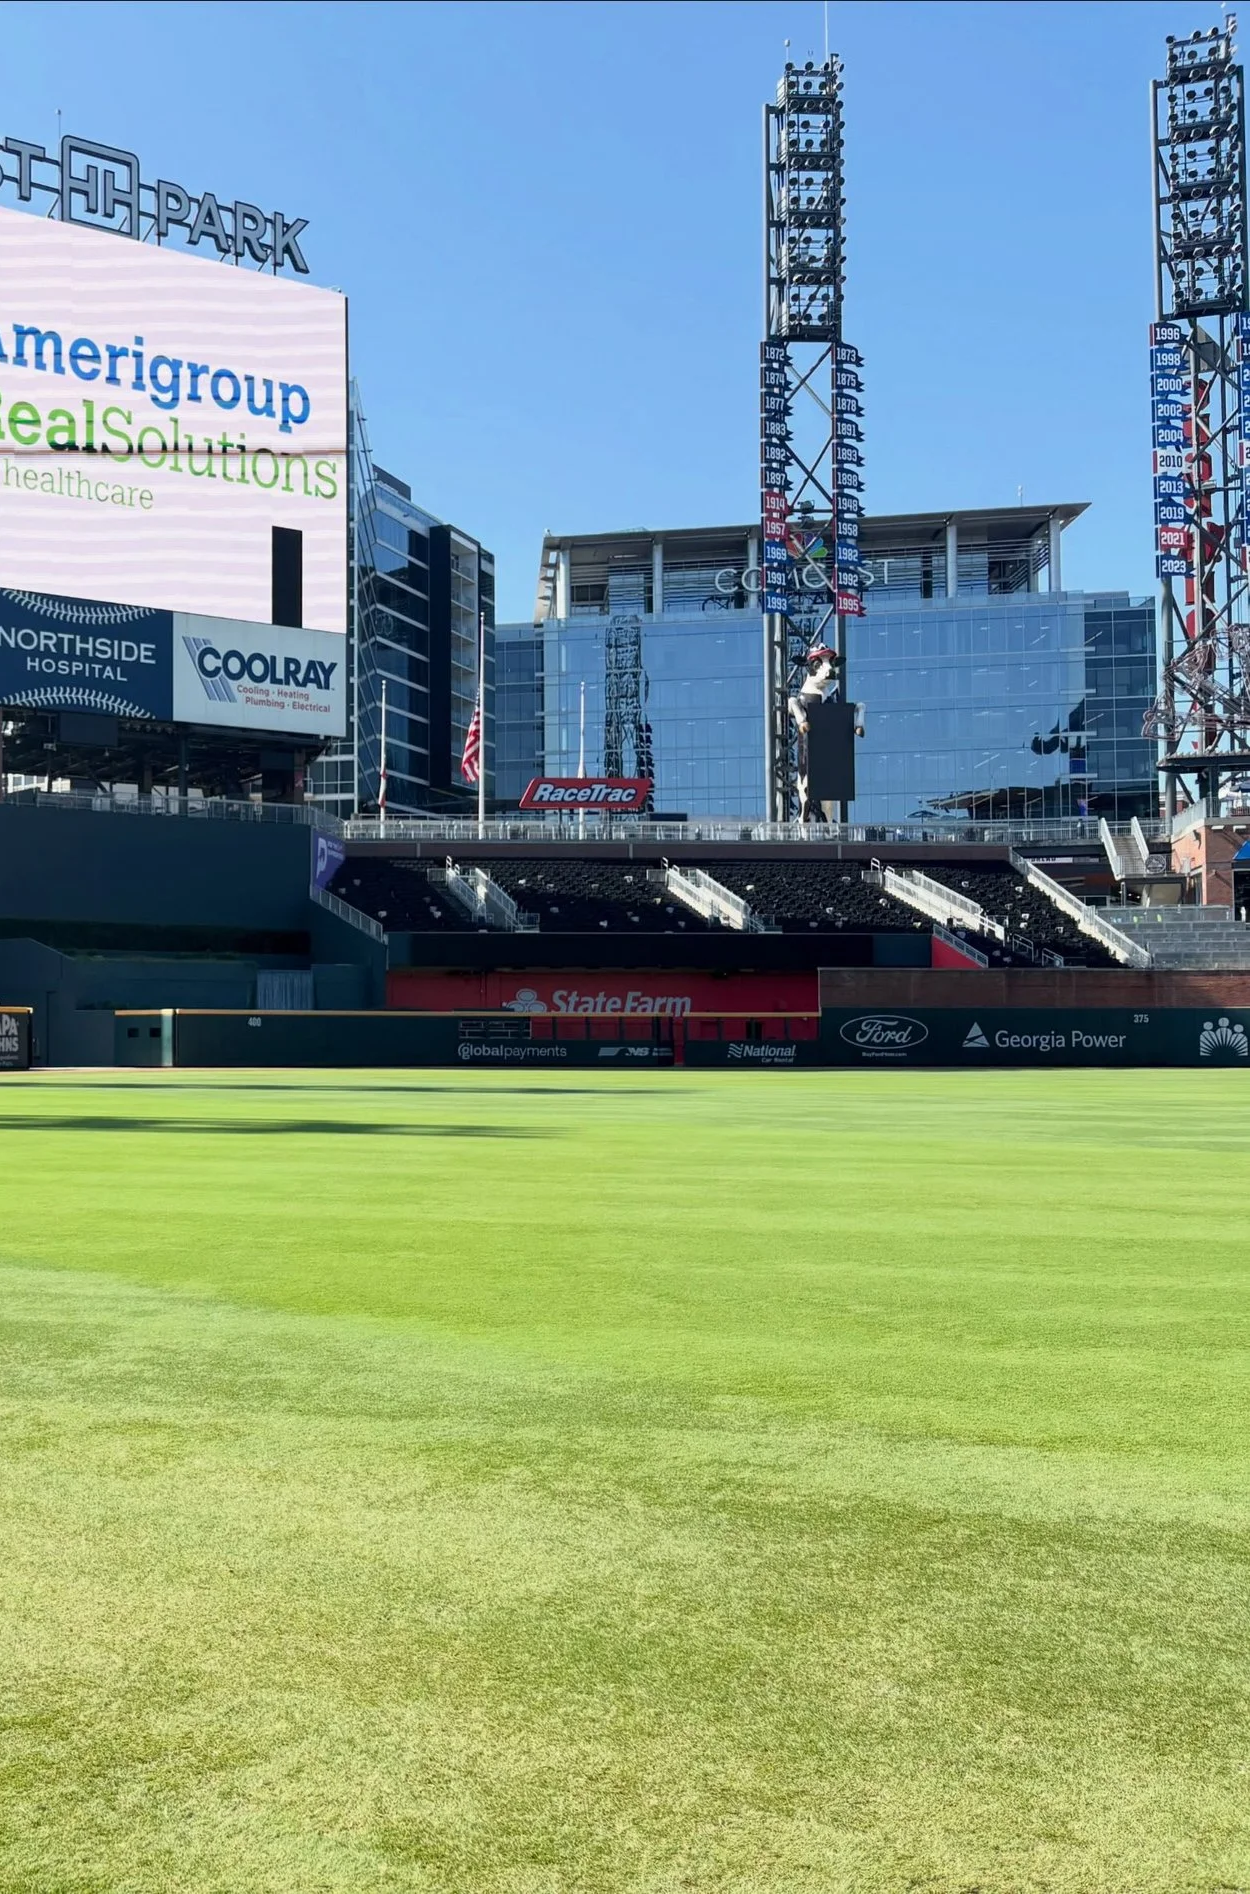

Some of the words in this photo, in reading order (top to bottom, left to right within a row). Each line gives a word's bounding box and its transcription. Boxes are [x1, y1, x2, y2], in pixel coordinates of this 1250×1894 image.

[157, 179, 310, 274] PARK
[1156, 327, 1180, 341] 1996
[765, 346, 785, 361] 1872
[836, 347, 856, 362] 1873
[1156, 353, 1181, 366] 1998
[765, 371, 785, 386] 1874
[836, 372, 856, 387] 1875
[1157, 378, 1182, 391] 2000
[765, 396, 785, 411] 1877
[836, 397, 857, 412] 1878
[1157, 403, 1183, 417] 2002
[765, 421, 786, 436] 1883
[837, 422, 857, 437] 1891
[1158, 429, 1184, 443] 2004
[765, 446, 786, 461] 1892
[837, 447, 858, 462] 1893
[1159, 455, 1183, 468] 2010
[3, 459, 154, 510] healthcare
[765, 471, 786, 486] 1897
[837, 471, 858, 487] 1898
[1160, 480, 1184, 494] 2013
[766, 496, 785, 511] 1914
[837, 496, 858, 511] 1948
[1160, 506, 1185, 520] 2019
[766, 521, 786, 536] 1957
[837, 522, 858, 537] 1958
[1161, 531, 1185, 545] 2021
[766, 546, 787, 560] 1969
[838, 547, 858, 561] 1982
[1161, 559, 1187, 573] 2023
[767, 571, 786, 586] 1991
[838, 572, 858, 587] 1992
[767, 596, 787, 611] 1993
[838, 597, 859, 611] 1995
[26, 657, 127, 682] HOSPITAL
[197, 646, 338, 690] COOLRAY
[237, 684, 270, 697] Cooling
[277, 690, 310, 701] Heating
[245, 696, 285, 710] Plumbing
[292, 701, 331, 713] Electrical
[532, 783, 636, 802] RaceTrac
[247, 1017, 262, 1027] 400
[1133, 1014, 1149, 1024] 375
[856, 1019, 913, 1044] Ford
[995, 1030, 1066, 1052] Georgia
[1071, 1031, 1126, 1048] Power
[743, 1044, 796, 1057] National
